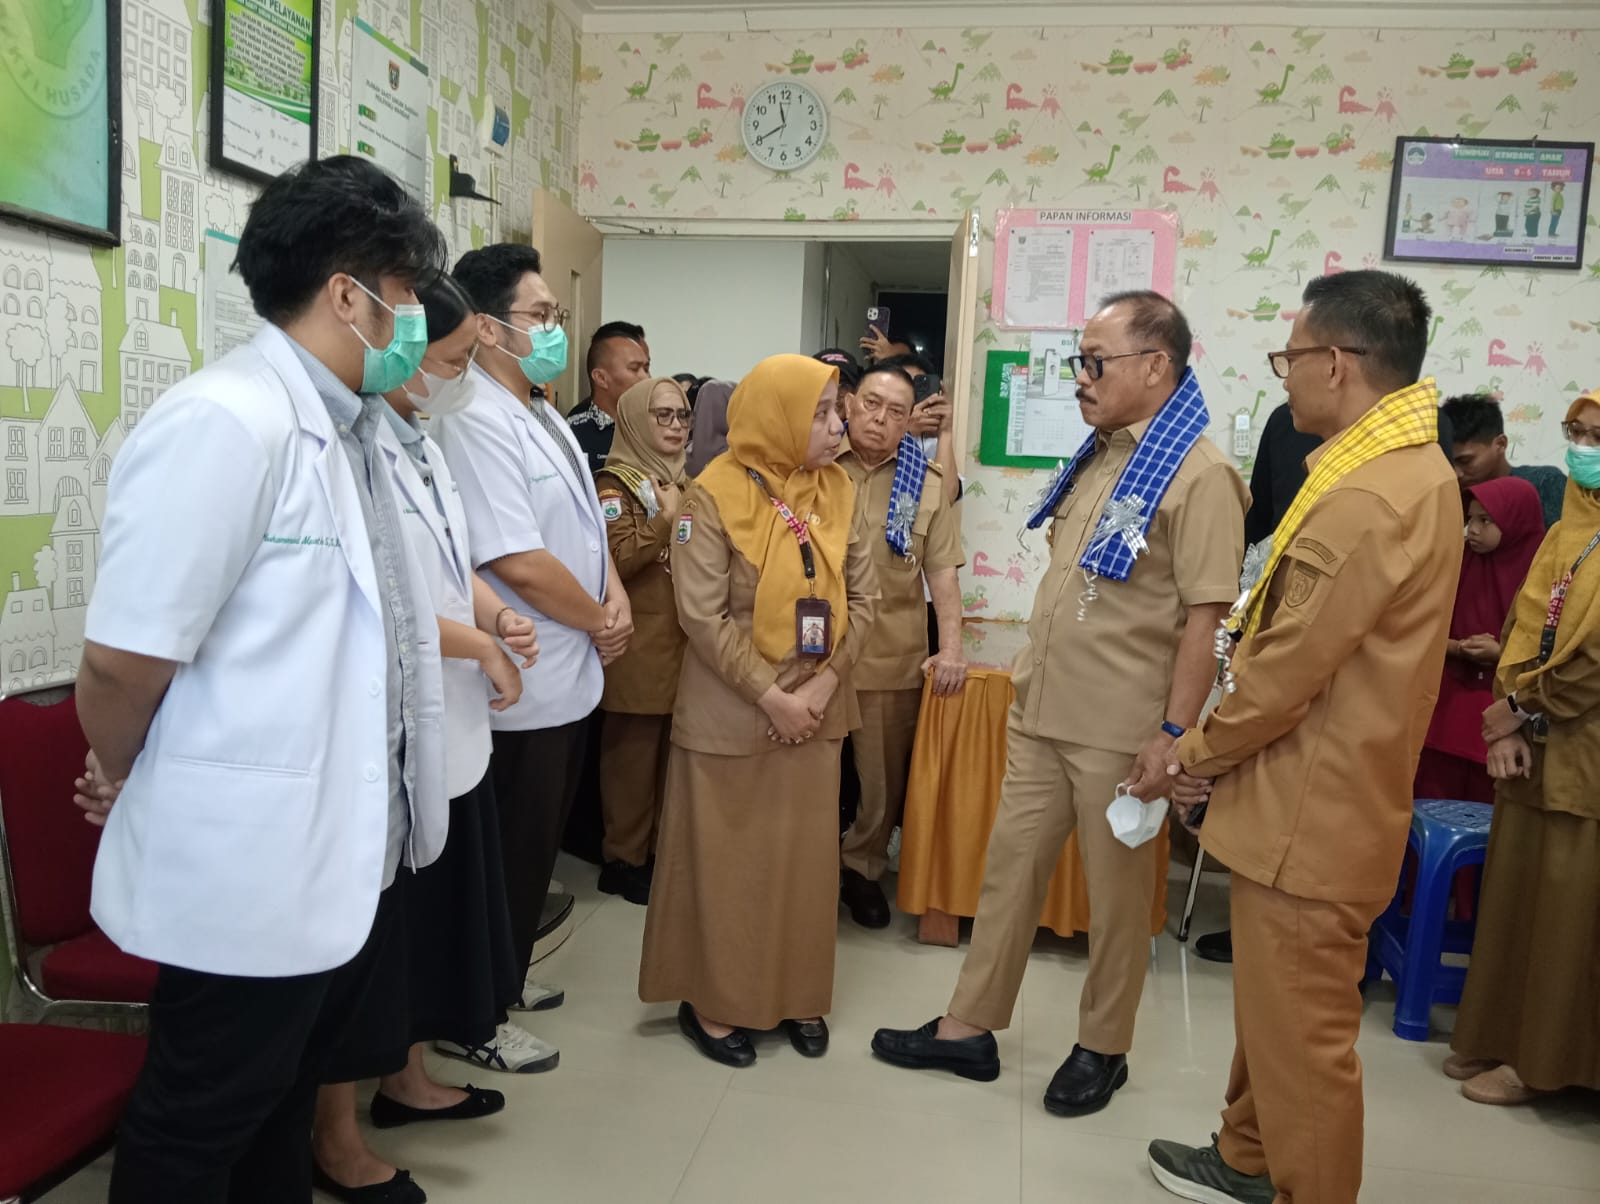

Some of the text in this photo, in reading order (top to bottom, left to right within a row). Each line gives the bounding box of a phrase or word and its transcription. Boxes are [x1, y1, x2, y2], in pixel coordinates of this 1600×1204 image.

[270, 0, 311, 31] PELAYANAN
[46, 49, 101, 106] HUSADA
[768, 94, 776, 104] 11
[781, 90, 791, 100] 12
[756, 105, 767, 115] 10
[808, 105, 814, 115] 2
[753, 120, 759, 131] 9
[810, 120, 817, 131] 3
[755, 135, 763, 146] 8
[805, 135, 812, 146] 4
[768, 147, 774, 157] 7
[780, 151, 787, 161] 6
[795, 146, 801, 157] 5
[1040, 211, 1132, 221] PAPAN INFORMASI
